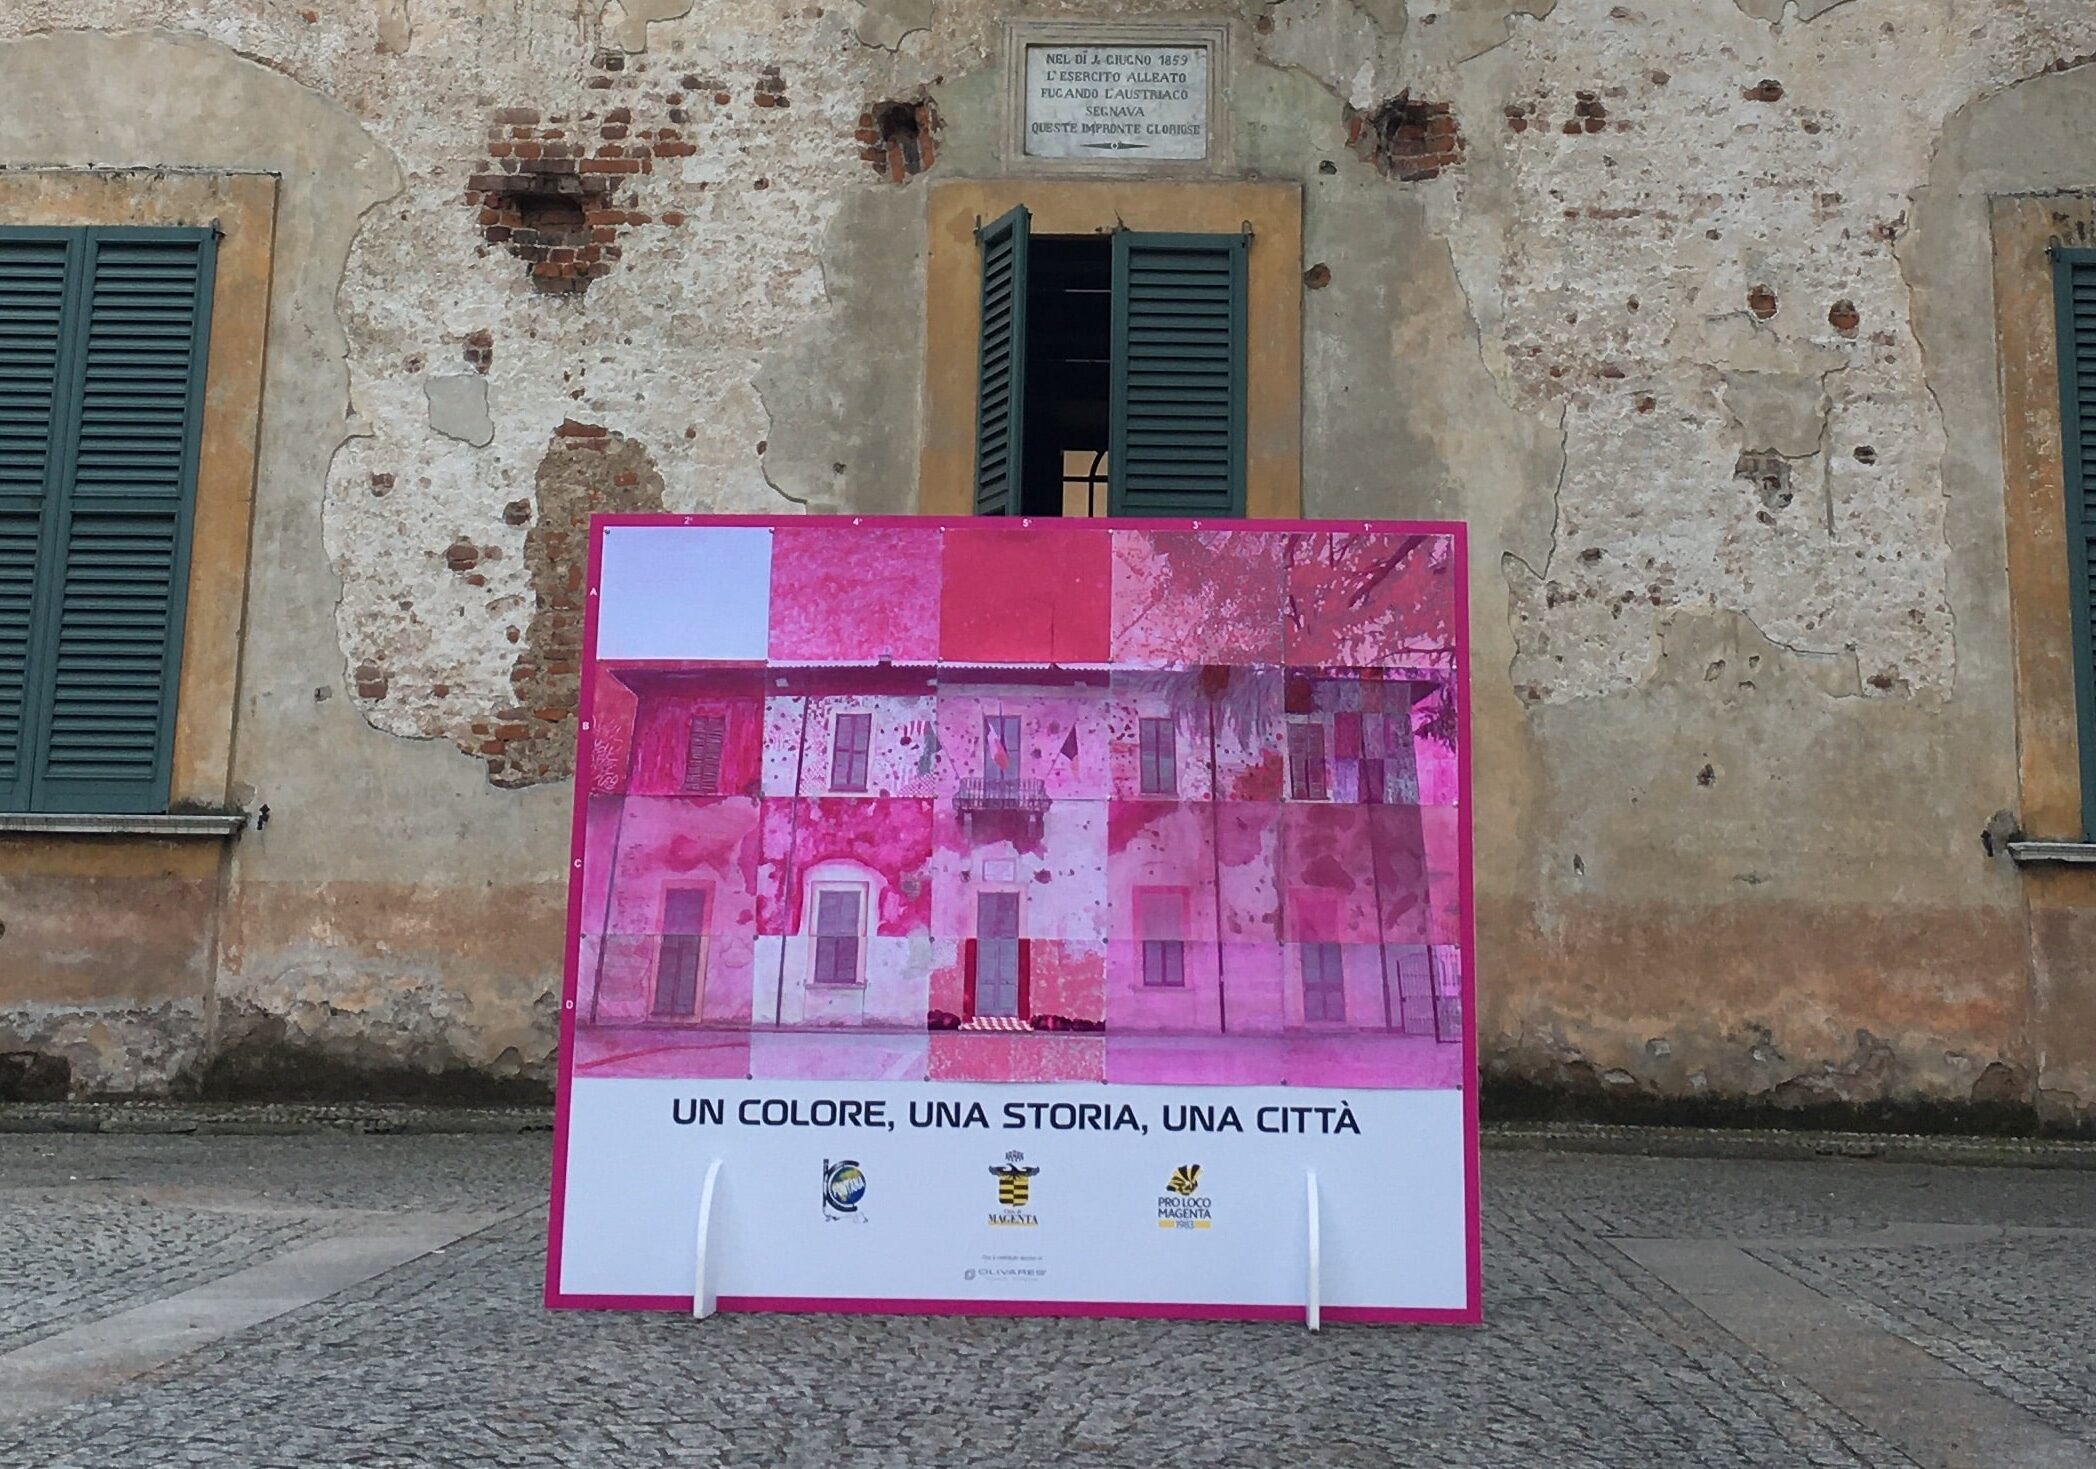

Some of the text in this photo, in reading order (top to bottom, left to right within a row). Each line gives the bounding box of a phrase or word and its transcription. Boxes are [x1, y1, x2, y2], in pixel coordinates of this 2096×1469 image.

[1046, 54, 1071, 65] NEL
[1106, 55, 1151, 66] GIUGNO
[1158, 55, 1188, 66] 1859
[1047, 71, 1187, 83] L'ESERCITO ALLEATO
[1041, 88, 1188, 100] FUGANDO L'AUSTRIACO
[1086, 107, 1145, 117] SEGNAVA
[1032, 122, 1200, 135] QUESTE IMPRONTE GLORIOSE
[589, 587, 598, 596] A
[582, 721, 590, 731] B
[573, 858, 582, 868] C
[673, 1098, 1361, 1135] UN COLORE, UNA STORIA, UNA CITTÀ
[1157, 1196, 1212, 1208] PRO LOCO
[1157, 1207, 1212, 1219] MAGENTA
[988, 1214, 1039, 1225] MAGENTA
